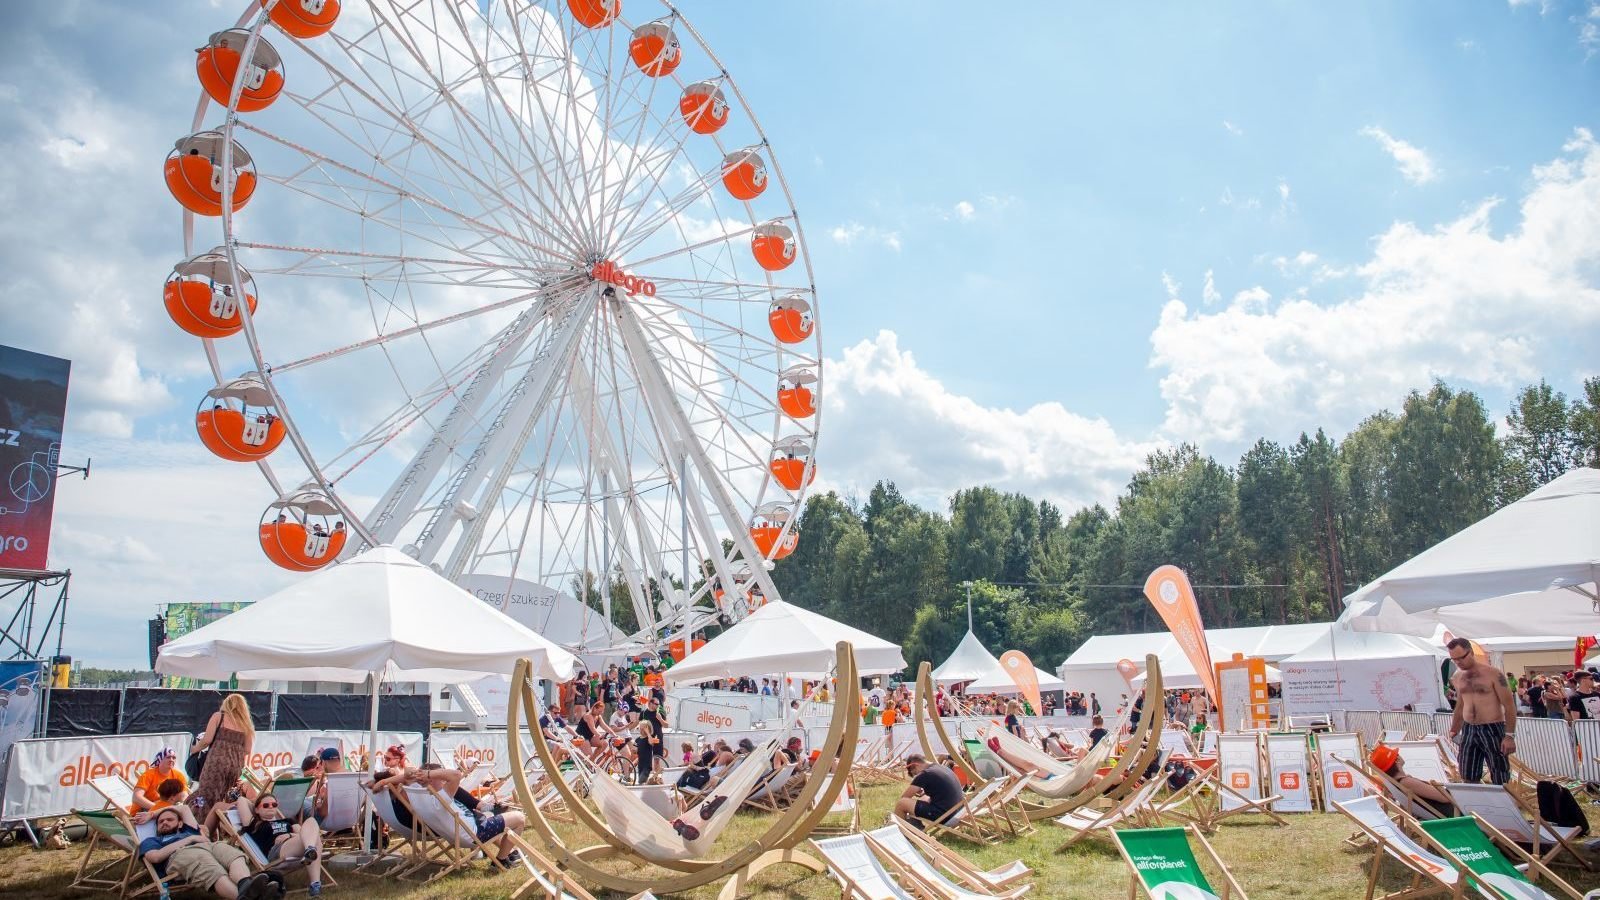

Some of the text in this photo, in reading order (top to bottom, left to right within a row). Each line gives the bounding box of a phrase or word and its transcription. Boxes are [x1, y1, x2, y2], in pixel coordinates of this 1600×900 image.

[592, 259, 656, 296] allegro
[0, 536, 28, 554] ro
[697, 710, 732, 729] allegro
